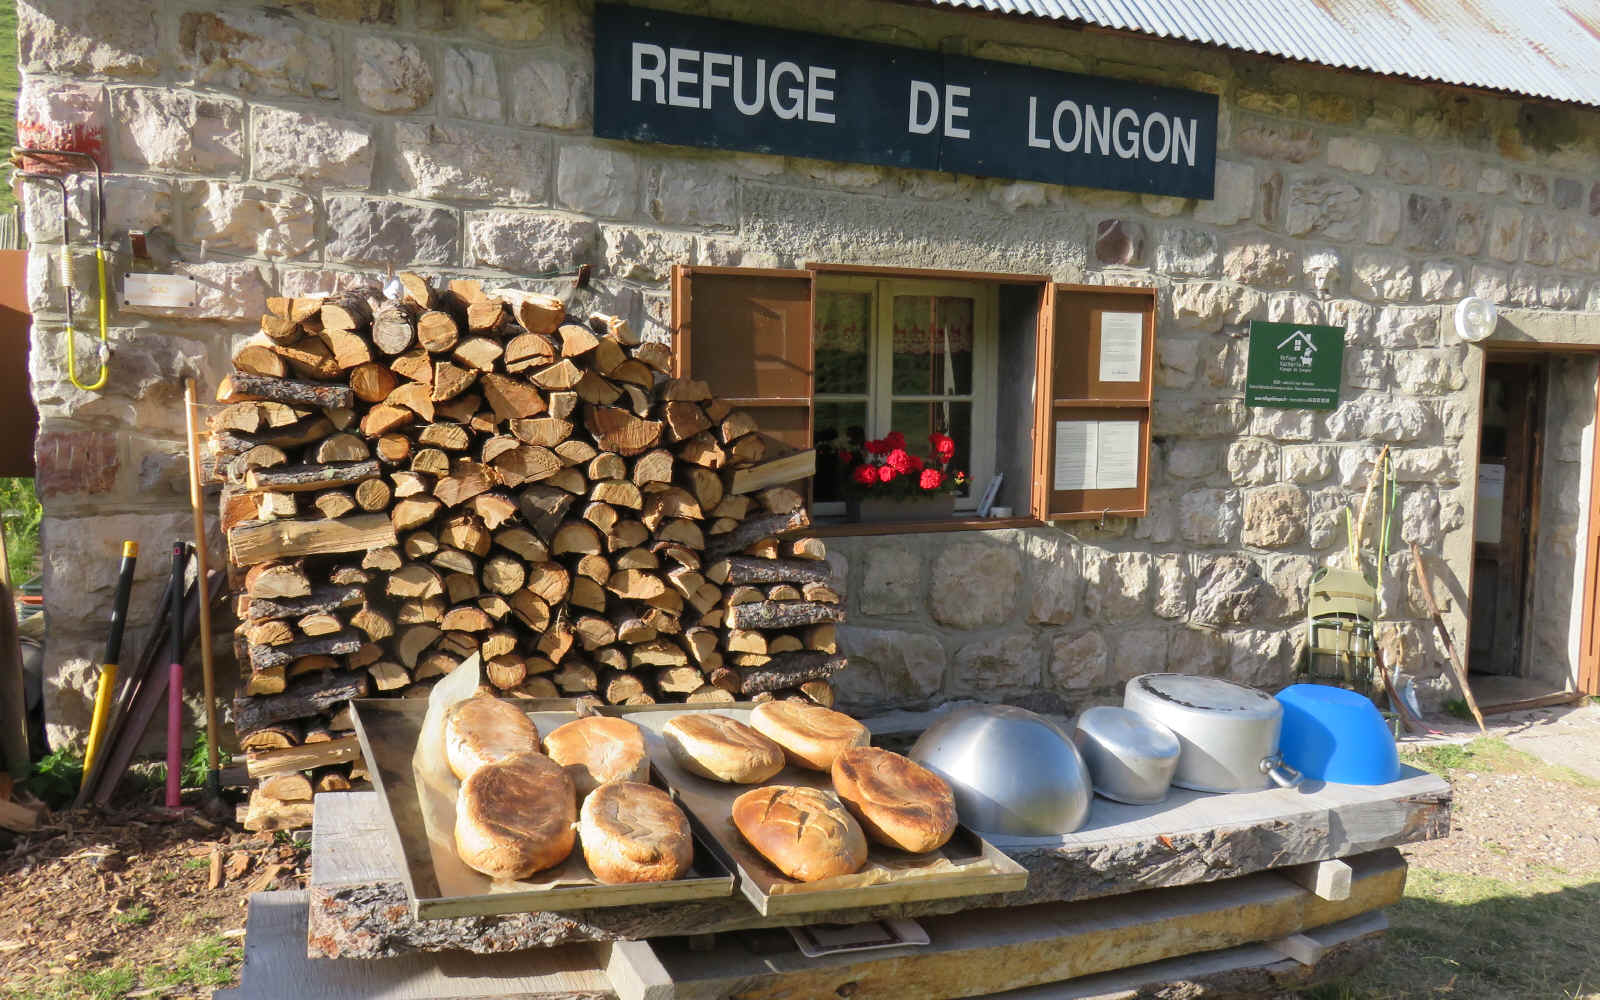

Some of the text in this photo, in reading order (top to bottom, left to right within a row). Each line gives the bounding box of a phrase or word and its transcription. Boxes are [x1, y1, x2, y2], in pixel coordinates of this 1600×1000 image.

[632, 43, 1196, 166] REFUGE DE LONGON
